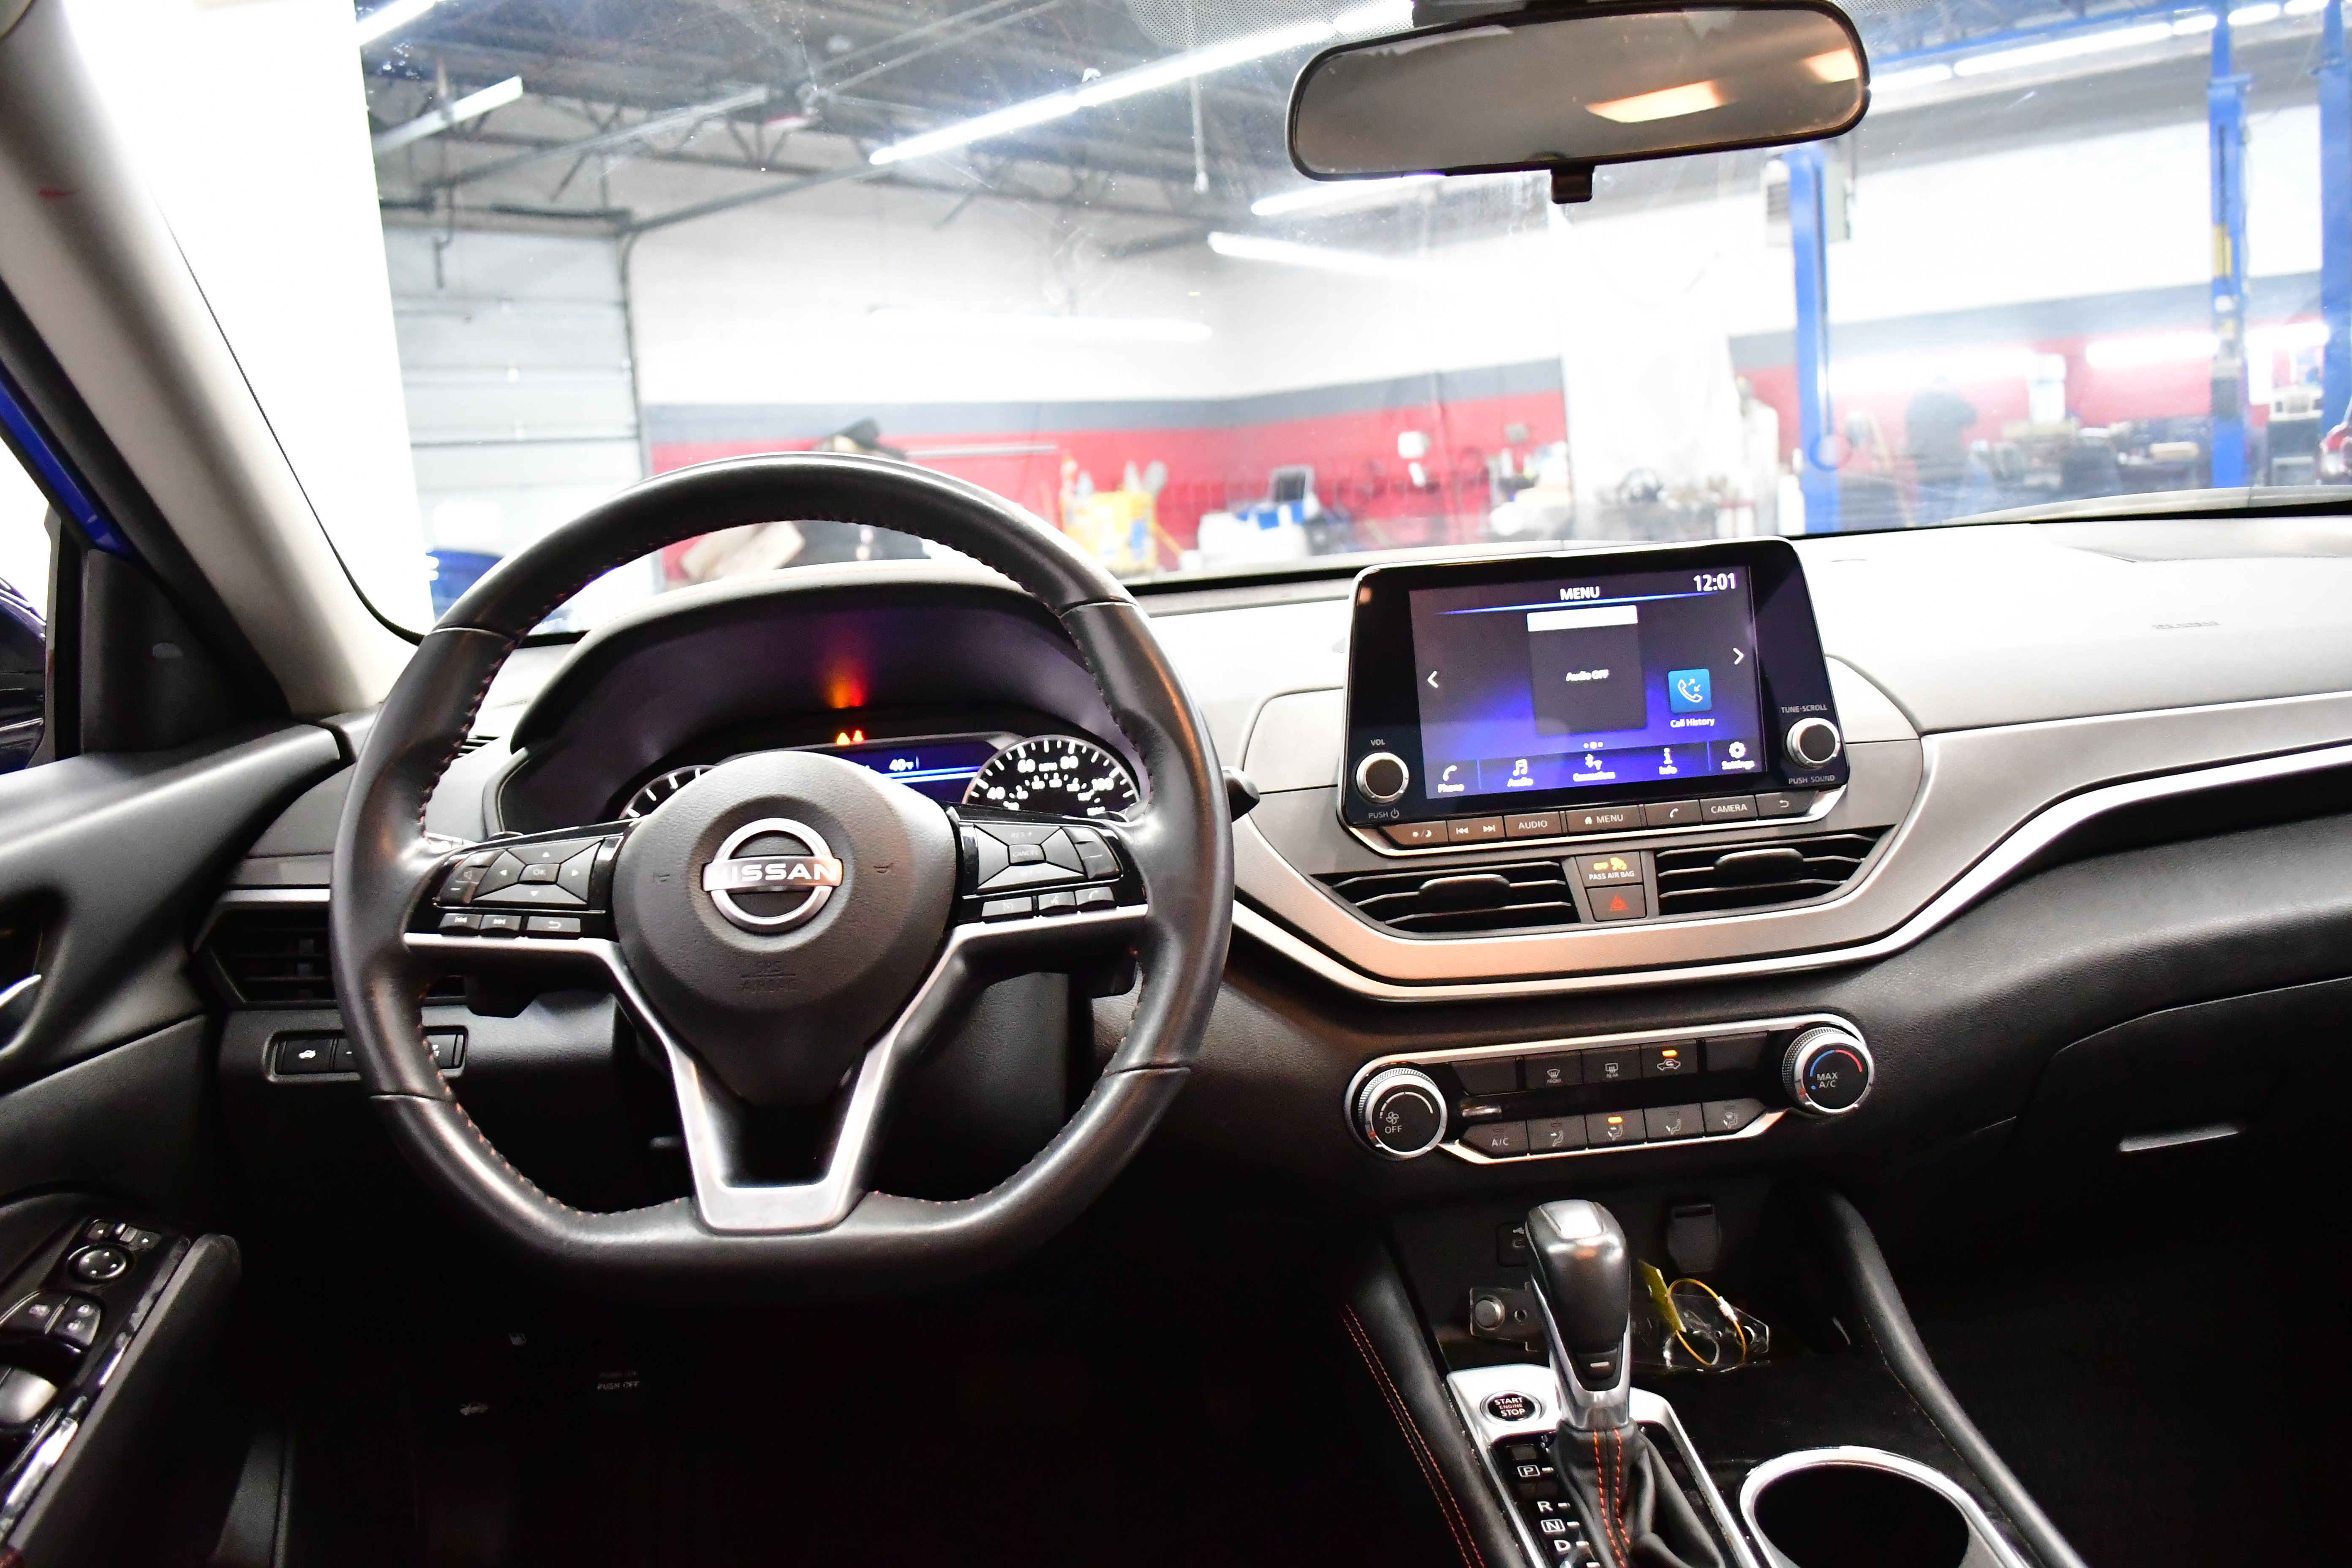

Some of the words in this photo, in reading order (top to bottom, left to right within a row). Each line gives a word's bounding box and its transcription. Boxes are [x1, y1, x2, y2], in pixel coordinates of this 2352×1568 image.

[1693, 572, 1737, 591] 12:01
[1560, 586, 1600, 600] MENU
[1670, 719, 1685, 728] Call
[1686, 718, 1715, 727] History
[1788, 776, 1808, 785] PUSH
[1810, 775, 1835, 783] SOUND
[1711, 803, 1748, 814] CAMERA
[1596, 814, 1624, 824] MENU
[1518, 819, 1548, 830] AUDIO
[1817, 1072, 1838, 1081] MAX
[1819, 1080, 1836, 1089] A/C
[1385, 1125, 1402, 1134] OFF
[1492, 1138, 1509, 1147] A/C
[1494, 1397, 1523, 1405] START
[1500, 1408, 1525, 1417] STOP
[1523, 1467, 1534, 1475] P
[1537, 1501, 1553, 1512] R
[1554, 1539, 1571, 1552] D
